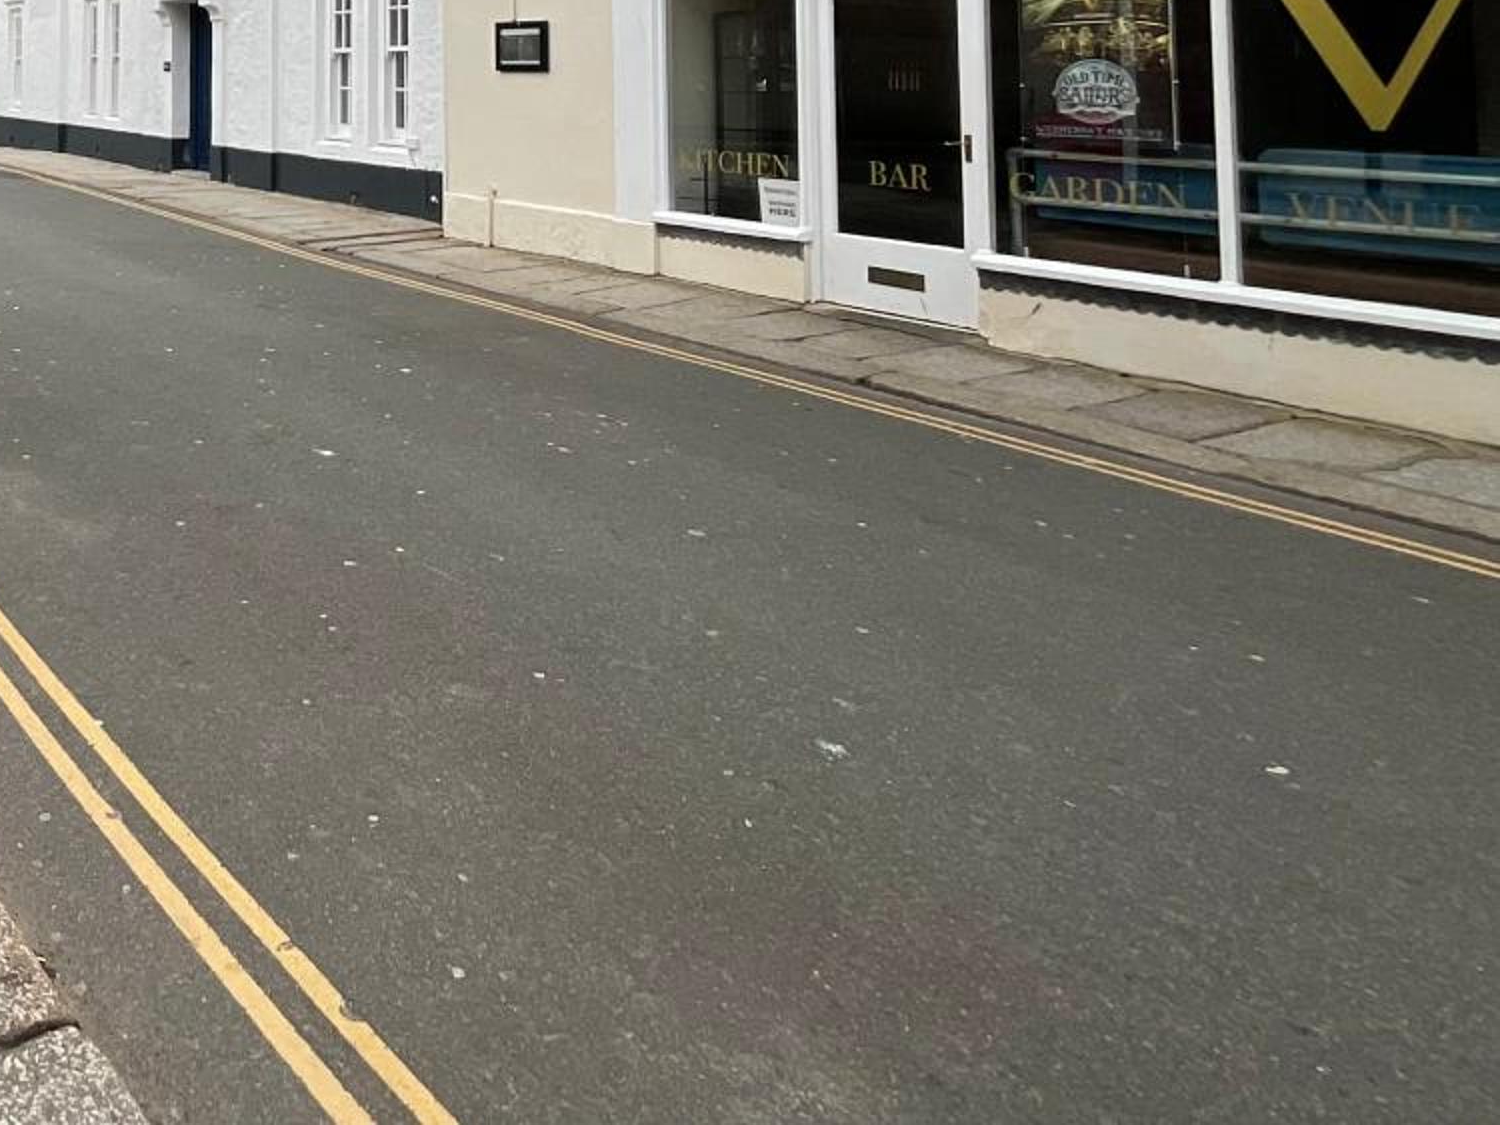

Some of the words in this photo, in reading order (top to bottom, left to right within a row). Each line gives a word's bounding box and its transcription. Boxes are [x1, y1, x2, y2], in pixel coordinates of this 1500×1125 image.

[677, 148, 790, 178] KITCHEN
[868, 160, 932, 192] BAR
[1009, 172, 1187, 209] GARDEN
